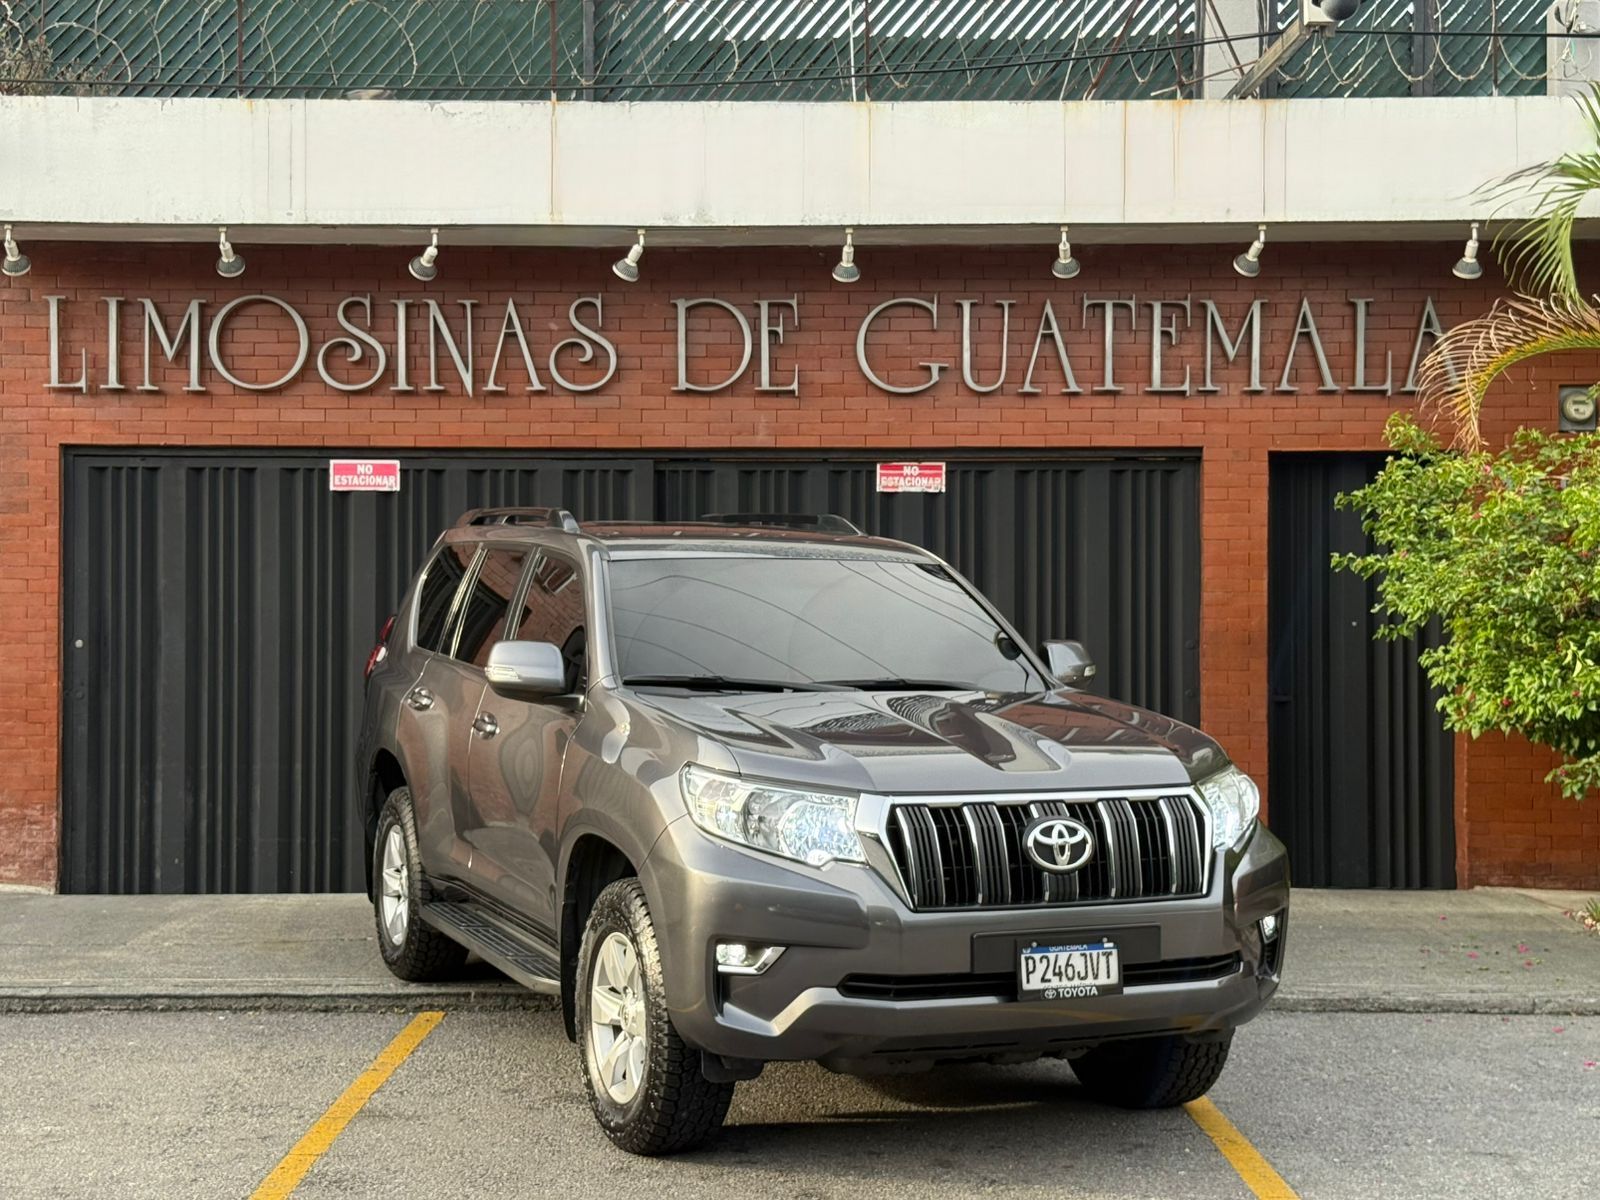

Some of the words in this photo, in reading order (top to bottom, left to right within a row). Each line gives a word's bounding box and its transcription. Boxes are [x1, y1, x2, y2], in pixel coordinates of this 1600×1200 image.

[43, 294, 618, 397] LIMOSINAS
[671, 293, 799, 396] DE
[856, 293, 1464, 397] GUATEMALA
[356, 464, 373, 475] NO
[903, 466, 920, 476] NO
[334, 475, 396, 486] ESTACIONAR
[880, 477, 942, 487] ESTACIONAR
[1024, 950, 1113, 984] P246JVT
[1058, 986, 1098, 998] TOYOTA
